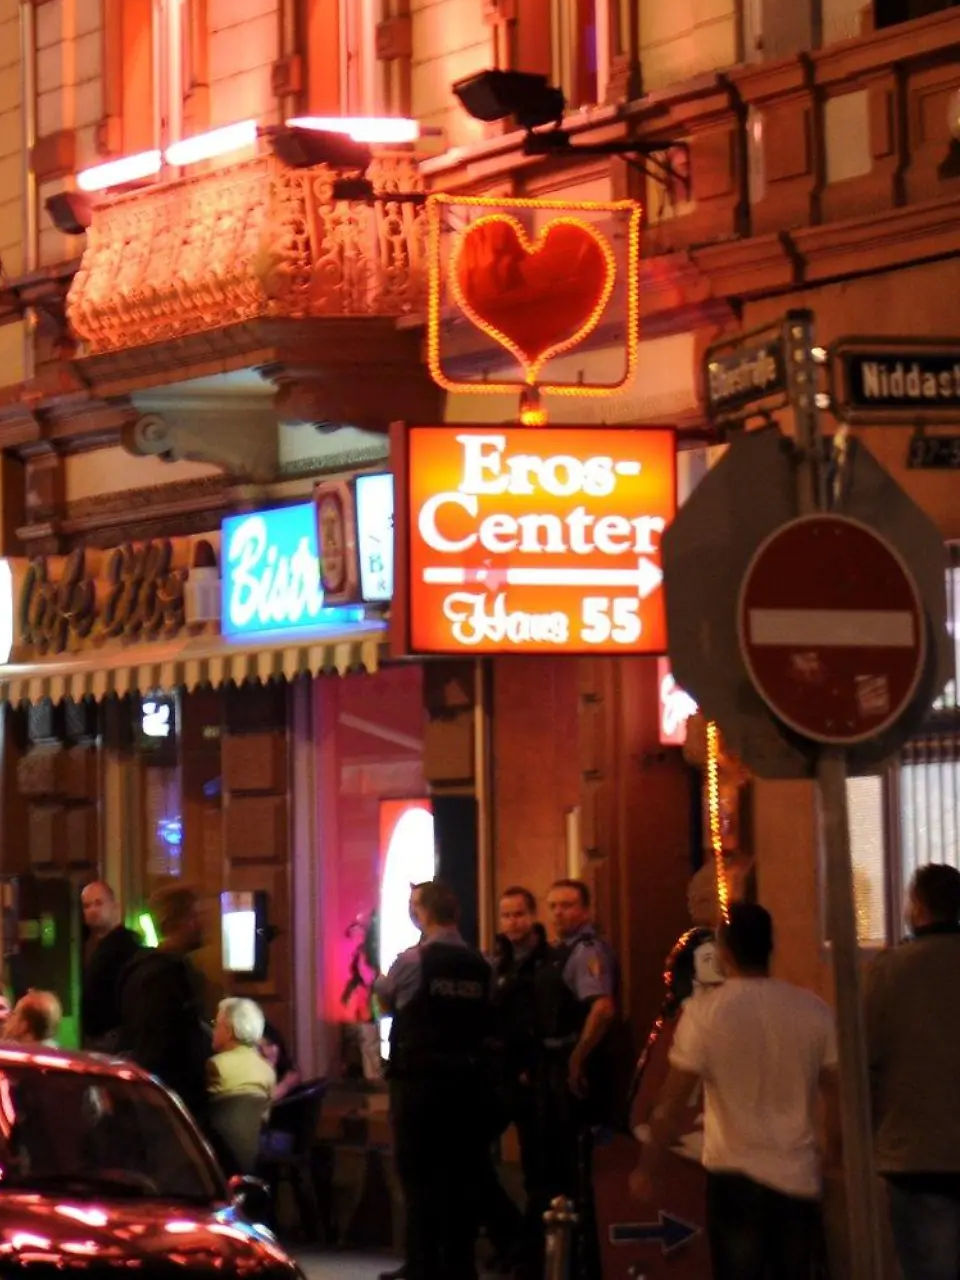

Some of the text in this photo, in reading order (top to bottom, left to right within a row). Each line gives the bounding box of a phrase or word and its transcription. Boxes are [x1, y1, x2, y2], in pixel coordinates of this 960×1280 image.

[455, 434, 642, 496] Eros-
[418, 491, 666, 554] Center
[228, 516, 325, 628] Bistr
[443, 592, 642, 645] Haus 55
